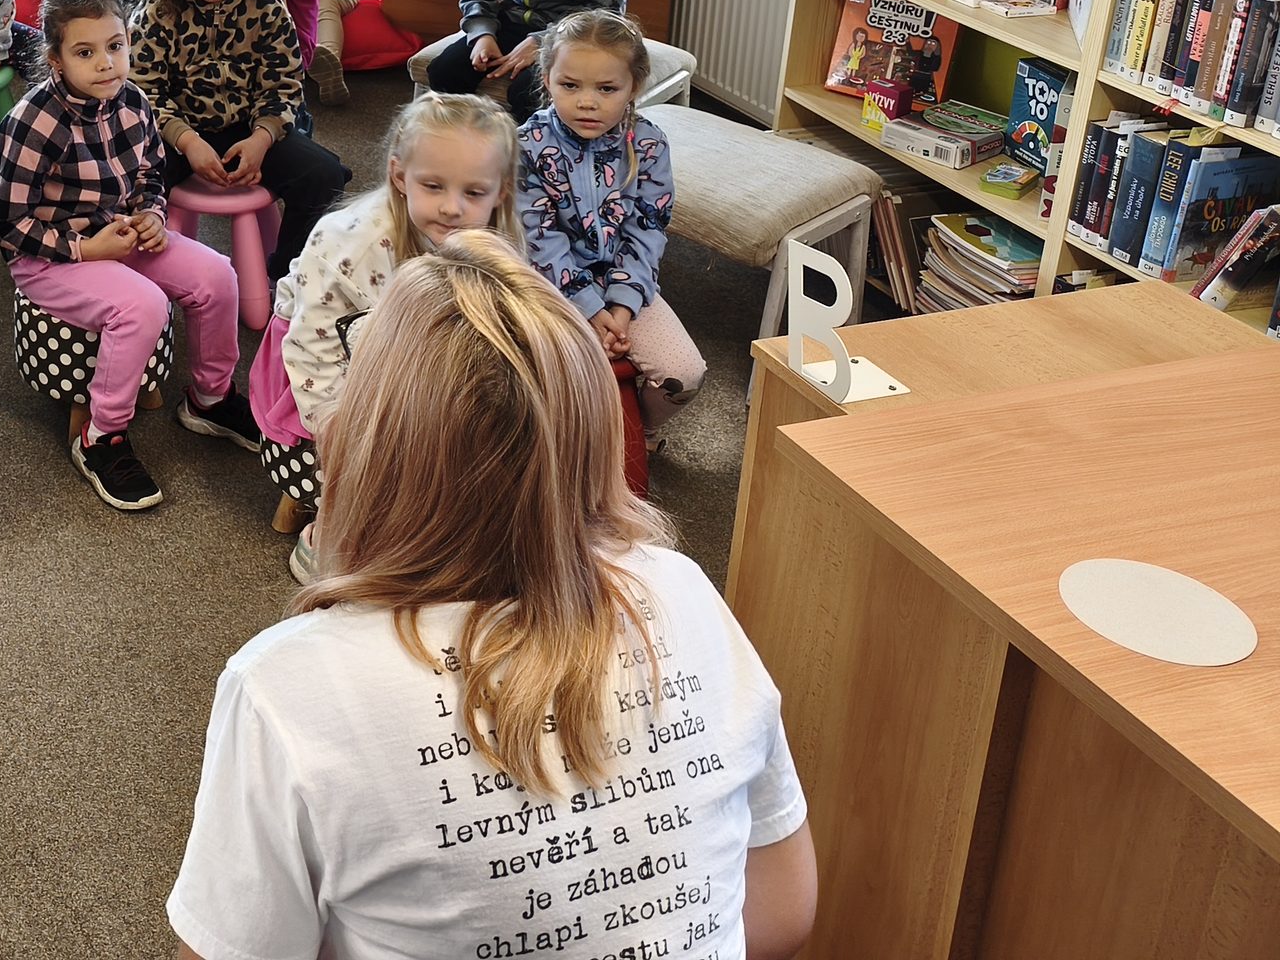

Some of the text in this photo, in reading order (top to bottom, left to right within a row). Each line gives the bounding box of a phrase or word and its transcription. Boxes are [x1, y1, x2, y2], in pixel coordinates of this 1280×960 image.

[884, 30, 907, 43] 2-3
[869, 91, 896, 111] VÝZVY
[1024, 78, 1059, 106] TOP
[1028, 98, 1048, 121] 10
[1264, 74, 1279, 106] SLEHLA
[1087, 138, 1097, 164] STOPA
[1159, 151, 1183, 202] LEE CHILD
[1123, 177, 1138, 219] Vzpomínky
[788, 240, 854, 404] B
[439, 709, 706, 805] i jenže
[435, 753, 724, 849] levným slibům ona
[489, 805, 692, 880] nevěří a tak
[522, 850, 688, 919] je záhadou
[476, 876, 712, 960] chlapi zkoušej
[683, 912, 721, 950] jak
